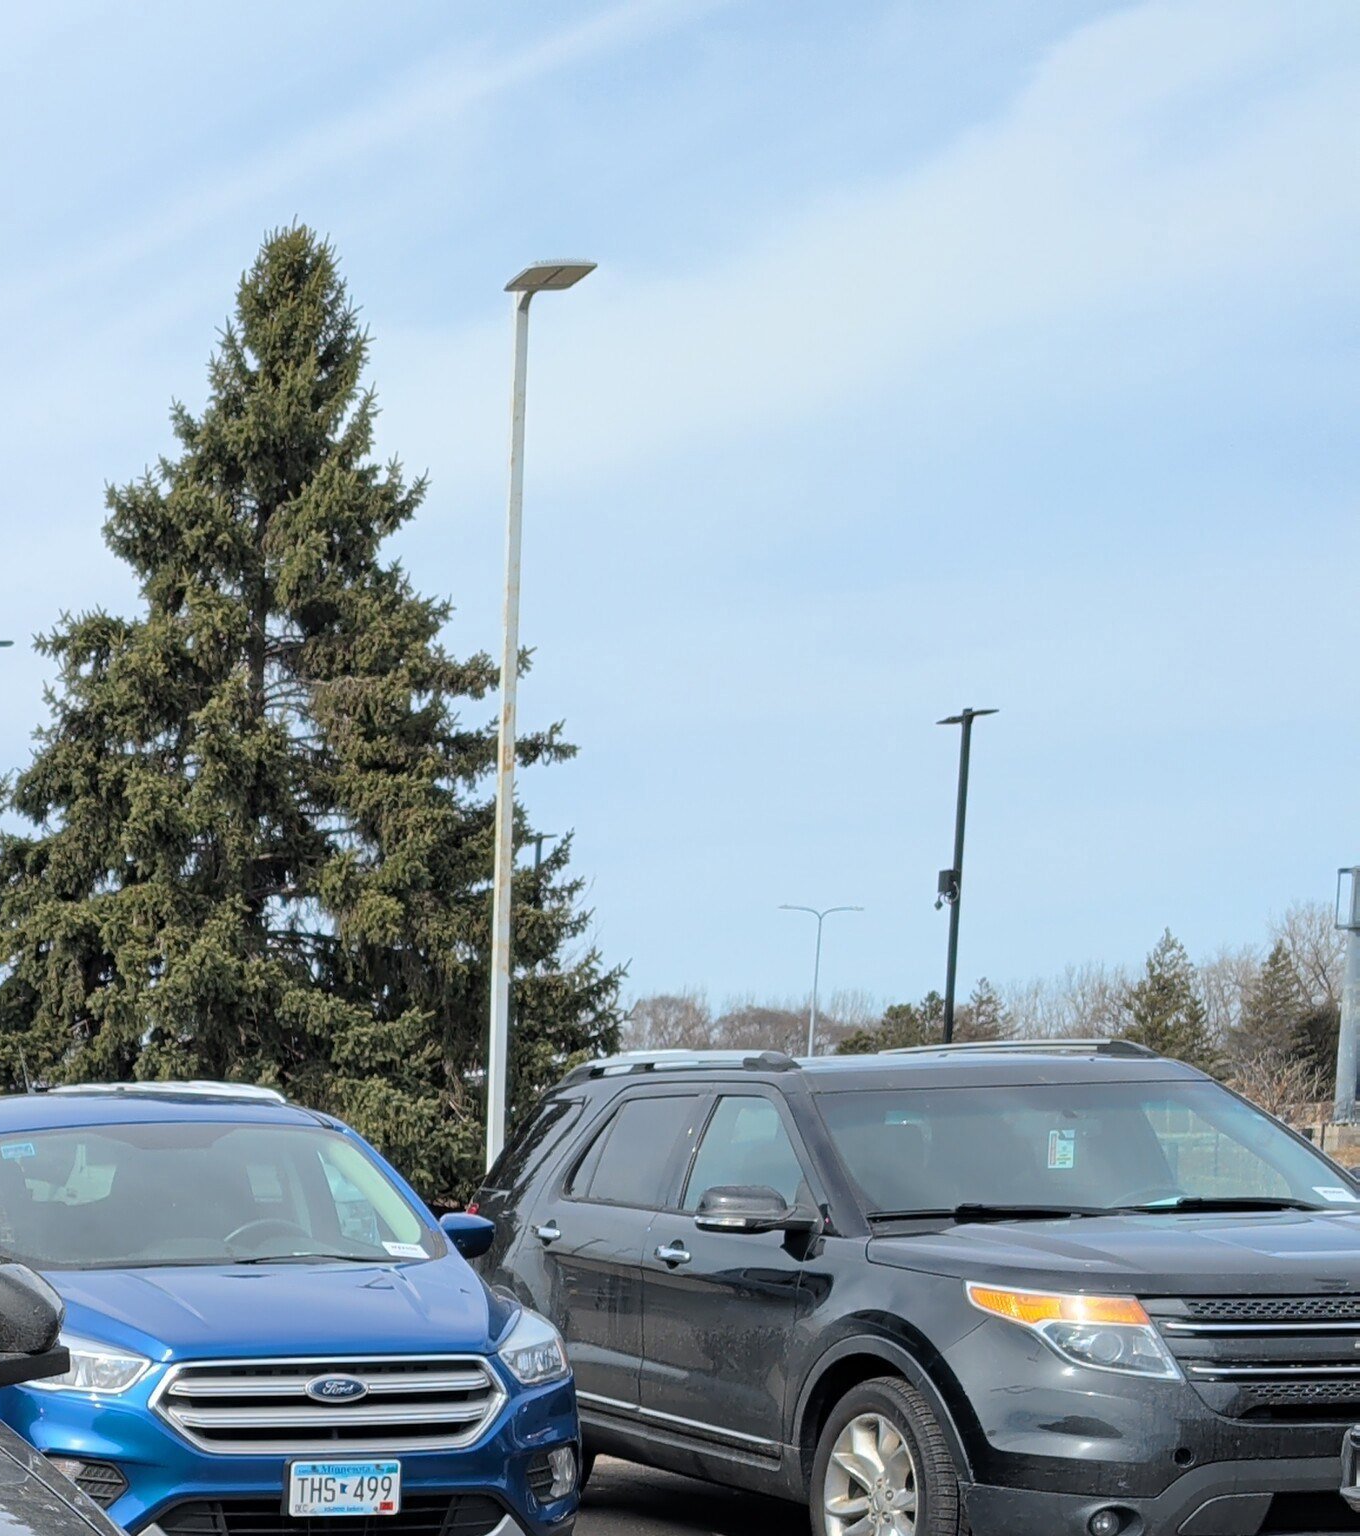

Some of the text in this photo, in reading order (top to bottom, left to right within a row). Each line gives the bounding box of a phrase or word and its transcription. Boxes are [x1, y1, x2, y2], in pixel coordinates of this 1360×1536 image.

[322, 1380, 355, 1396] Ford
[321, 1464, 371, 1476] Minnesota
[298, 1476, 393, 1503] THS 499
